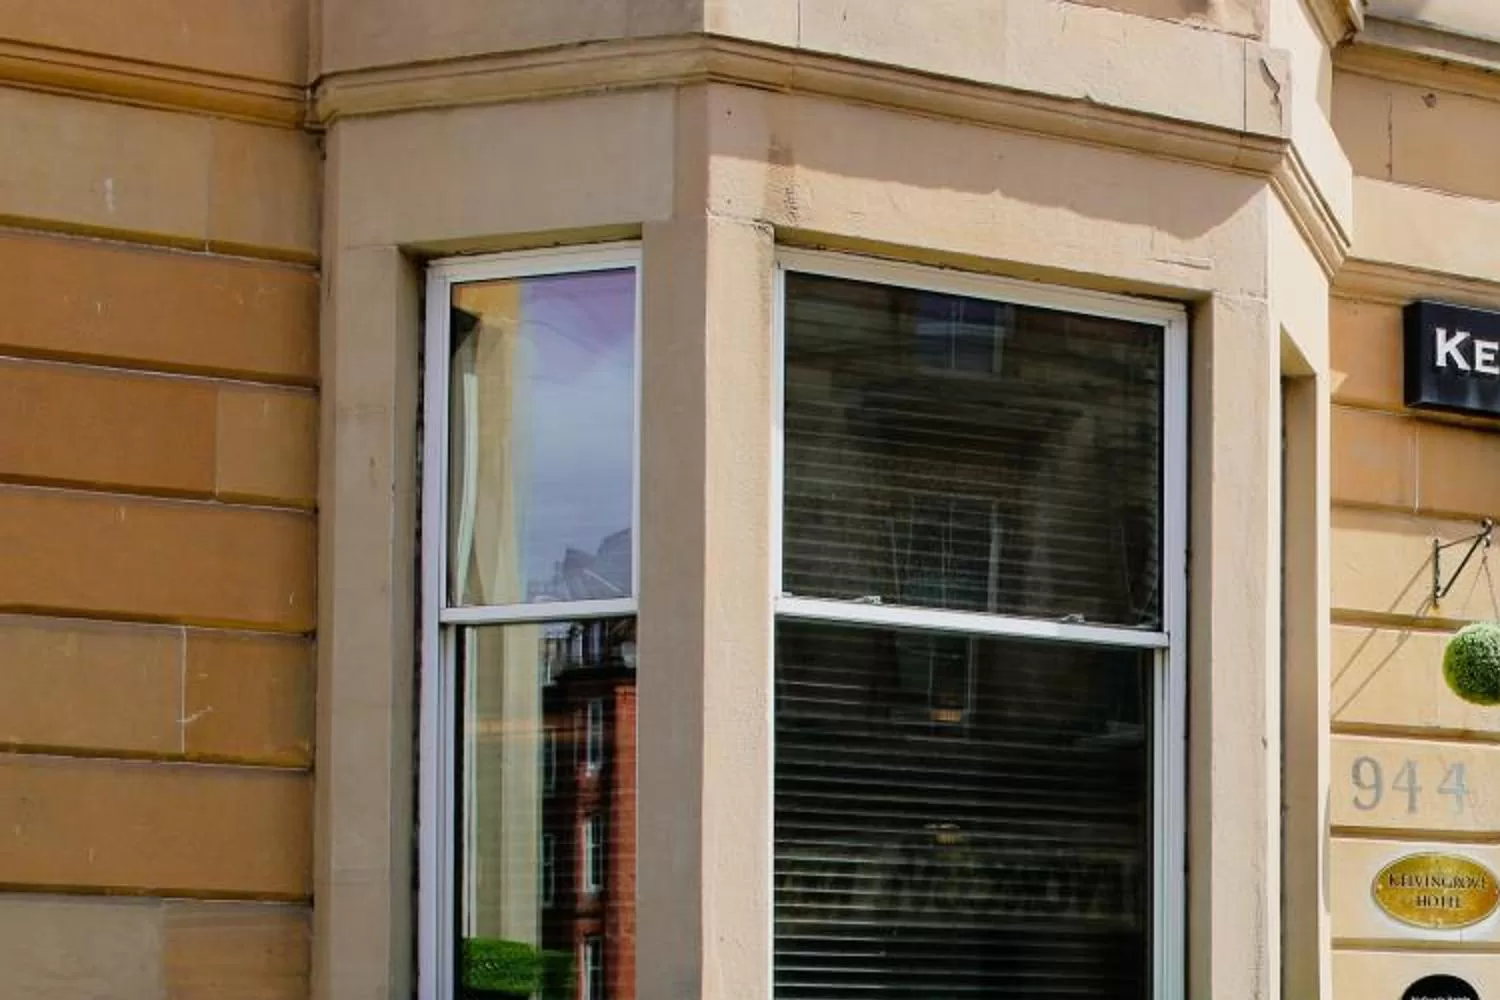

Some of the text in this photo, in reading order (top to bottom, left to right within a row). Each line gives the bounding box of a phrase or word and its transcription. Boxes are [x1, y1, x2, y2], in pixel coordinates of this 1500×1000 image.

[1351, 756, 1470, 814] 944
[1388, 872, 1488, 890] KELVINGROVE
[1416, 895, 1462, 909] HOTEL
